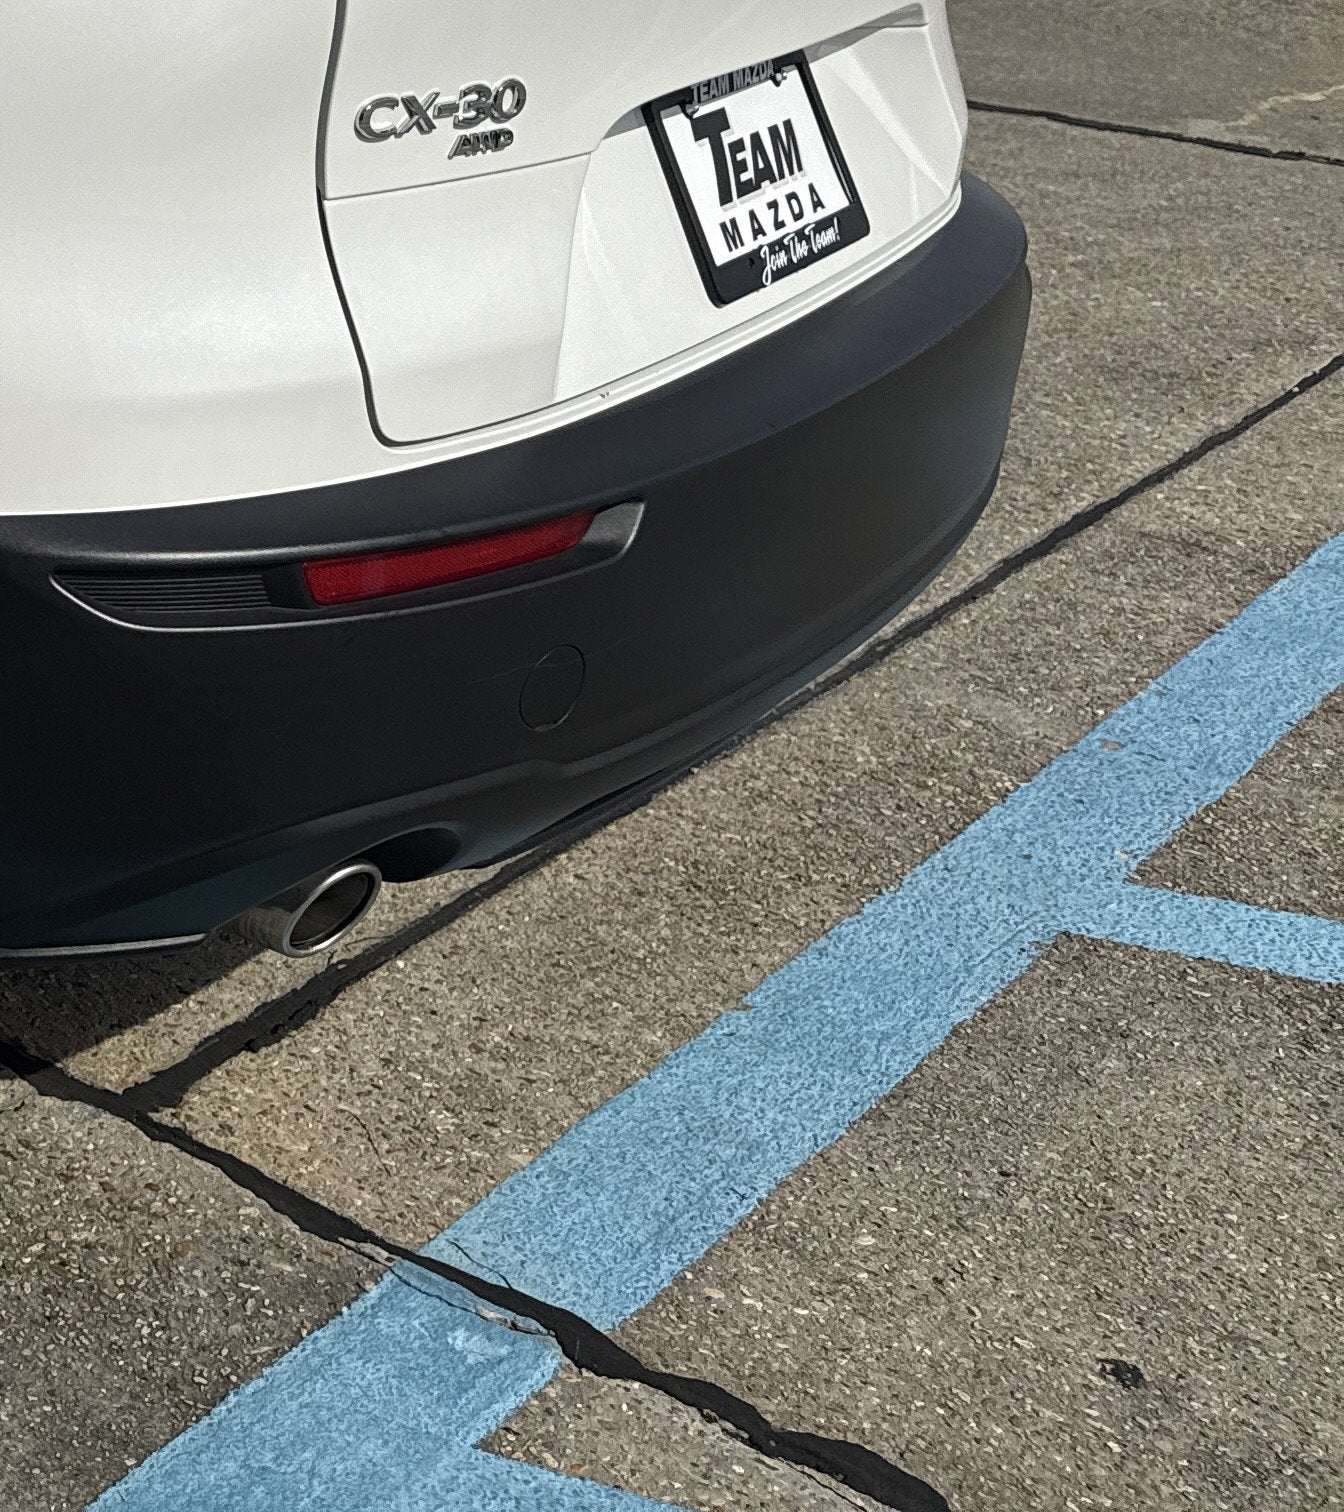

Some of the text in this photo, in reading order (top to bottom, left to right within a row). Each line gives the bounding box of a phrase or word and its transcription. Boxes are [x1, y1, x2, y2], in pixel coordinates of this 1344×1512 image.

[354, 78, 527, 143] CX-30
[691, 60, 775, 104] TEAM MAZDA
[447, 128, 514, 159] AWD
[690, 107, 803, 207] TEAM
[719, 183, 825, 252] MAZDA
[760, 217, 841, 286] Join The Team!
